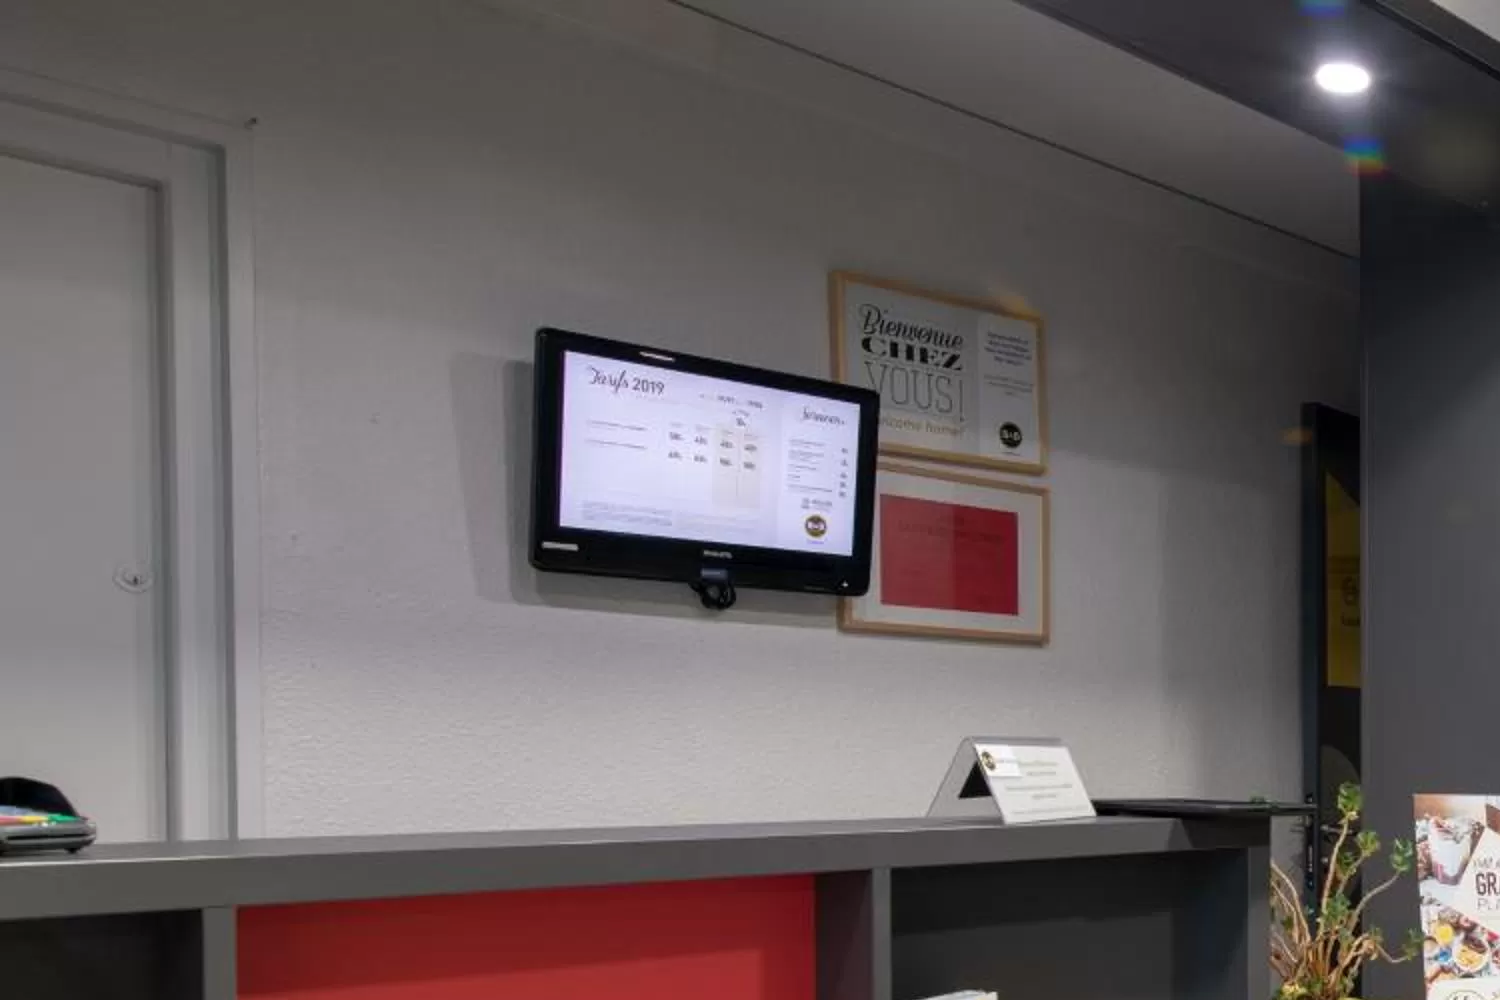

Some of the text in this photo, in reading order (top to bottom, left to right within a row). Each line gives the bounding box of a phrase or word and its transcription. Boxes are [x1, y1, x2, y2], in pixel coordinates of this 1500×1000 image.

[860, 303, 964, 349] Bienvenue
[861, 337, 963, 371] CHEZ
[632, 377, 665, 395] 2019
